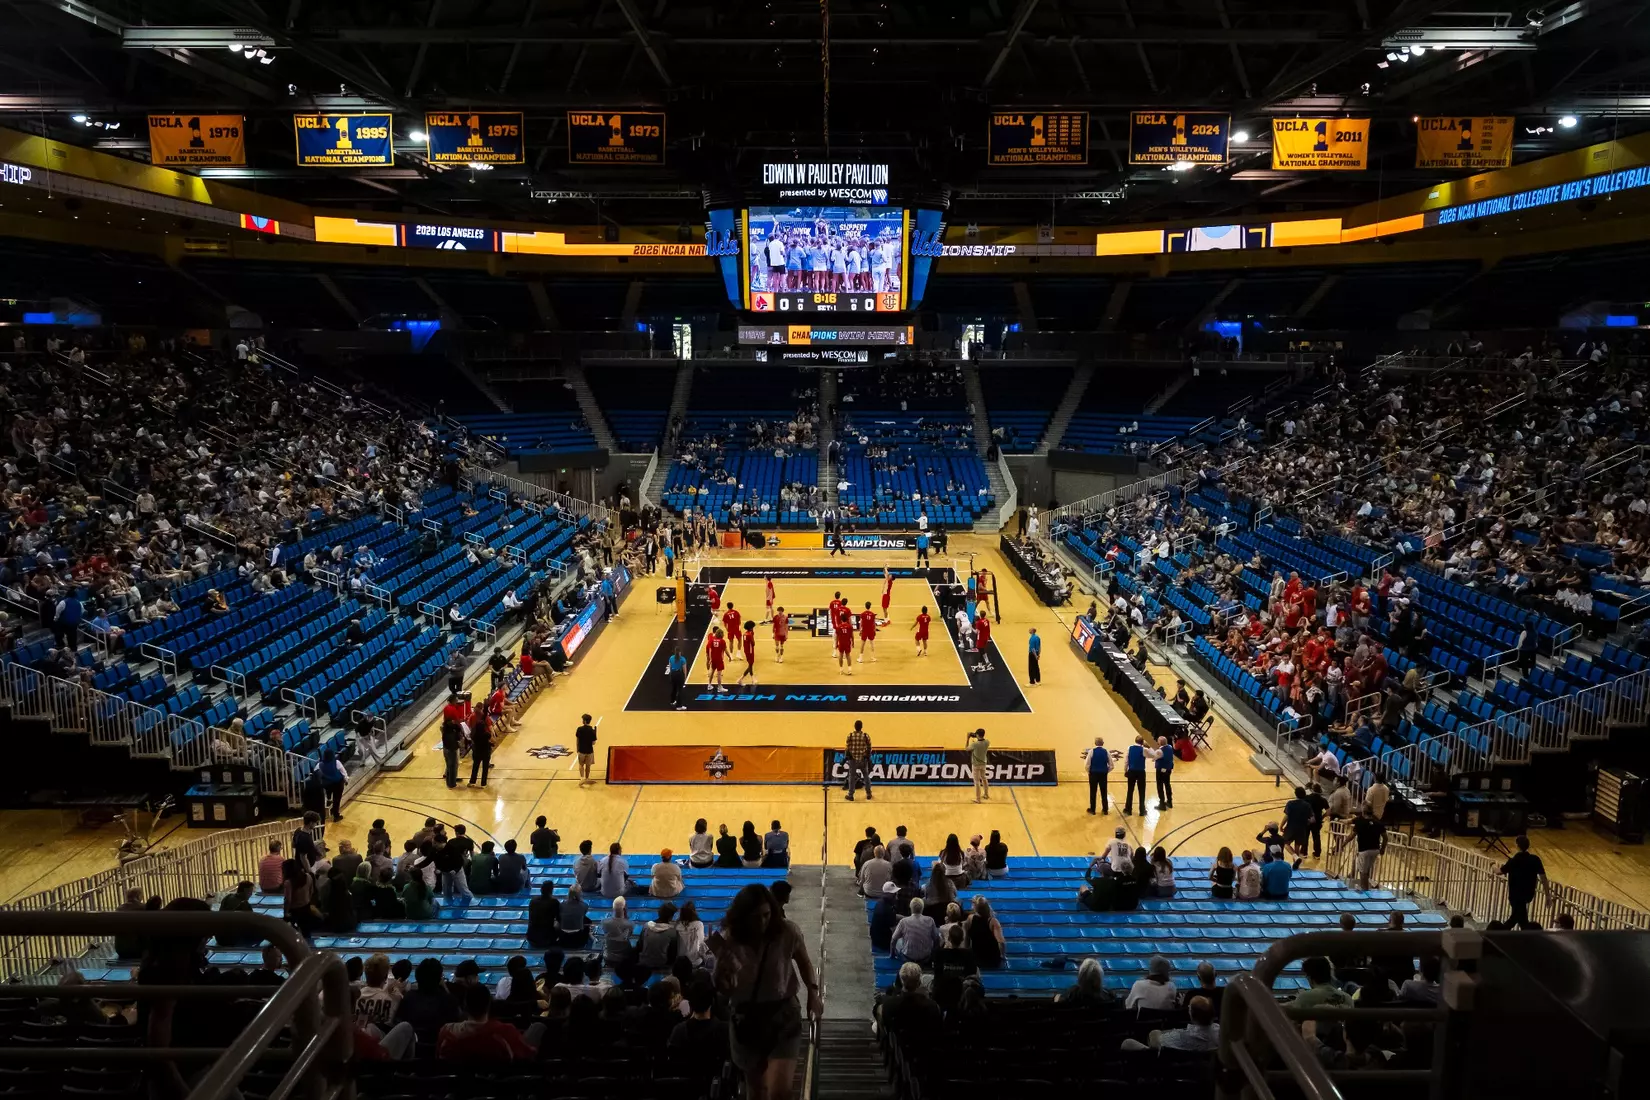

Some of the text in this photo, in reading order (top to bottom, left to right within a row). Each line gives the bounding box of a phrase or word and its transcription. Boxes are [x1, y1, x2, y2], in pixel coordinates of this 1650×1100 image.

[150, 118, 183, 128] UCLA
[188, 117, 204, 148] 1
[297, 118, 387, 148] UCLA 1 1995
[429, 115, 518, 146] UCLA 1 1975
[572, 115, 659, 146] UCLA 1 1973
[994, 116, 1025, 126] UCLA
[1031, 115, 1045, 146] 1
[1136, 115, 1220, 145] UCLA 1 2024
[1276, 122, 1362, 151] UCLA 1 2011
[1421, 119, 1457, 130] UCLA
[1457, 119, 1474, 150] 1
[763, 164, 888, 184] EDWIN W PAULEY PAVILION
[780, 189, 872, 198] presented by WESCOM
[1438, 209, 1457, 224] 2026
[1458, 204, 1476, 221] NCAA
[1477, 197, 1511, 218] NATIONAL
[1513, 188, 1560, 210] COLLEGIATE
[1561, 181, 1591, 200] MEN'S
[416, 225, 484, 239] 2026 LOS ANGELES
[633, 246, 658, 255] 2026
[661, 246, 686, 255] NCAA
[779, 298, 789, 310] 0
[865, 298, 874, 310] 0
[792, 331, 895, 340] CHAMPIONS WIN HERE
[822, 351, 856, 359] WESCOM
[785, 694, 848, 702] WIN
[886, 752, 946, 764] VOLLEYBALL
[832, 763, 1045, 779] CAMPIONSHIP
